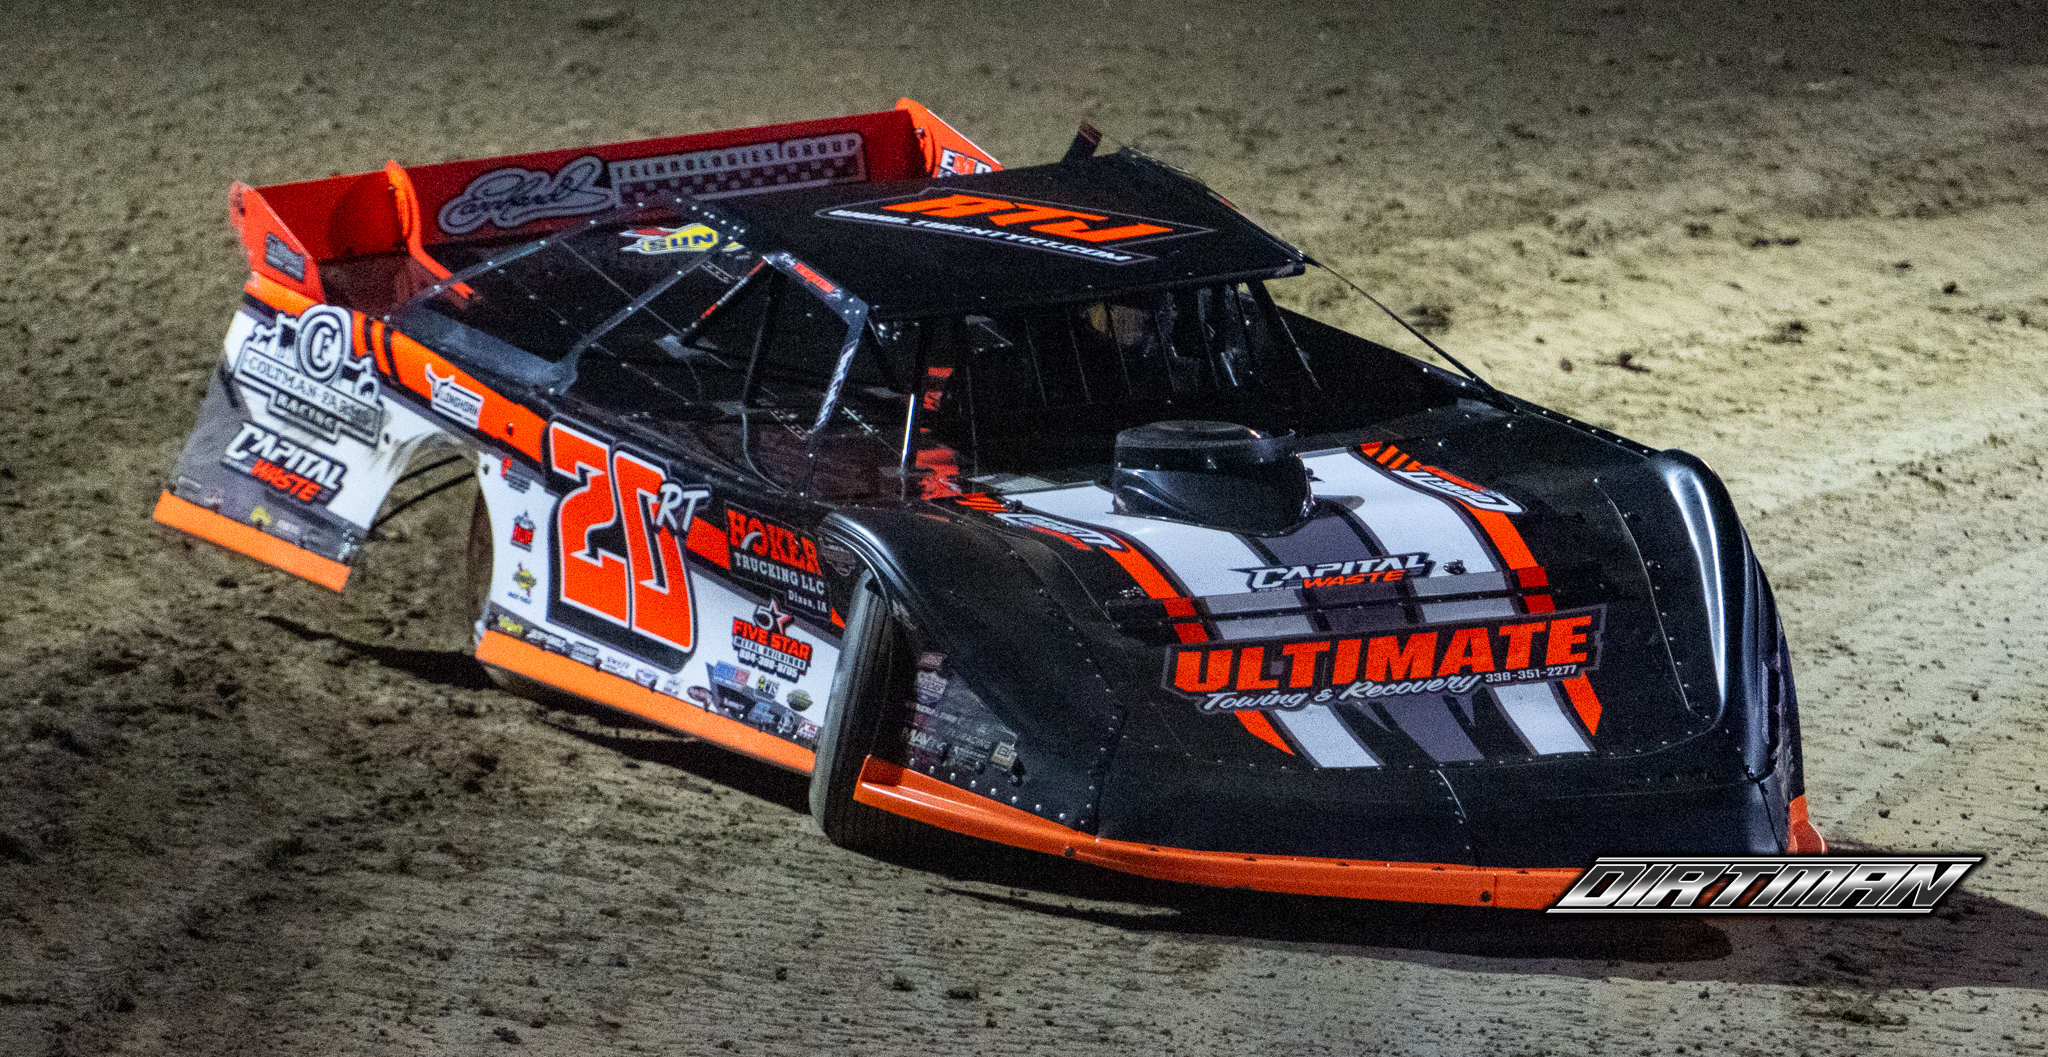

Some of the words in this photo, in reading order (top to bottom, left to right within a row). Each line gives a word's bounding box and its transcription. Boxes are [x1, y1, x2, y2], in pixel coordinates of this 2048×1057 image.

[616, 149, 773, 178] TECHNOLOGIES
[789, 137, 857, 159] GROUP
[278, 394, 336, 431] RACING
[226, 422, 347, 490] CAPITAL
[250, 459, 321, 501] WASTE
[655, 484, 710, 530] RT
[727, 508, 823, 576] HOKER
[734, 550, 799, 588] TRUCKING
[800, 570, 826, 596] LLC
[1252, 554, 1426, 588] CAPITAL
[1304, 569, 1405, 588] WASTE
[733, 618, 768, 645] FIVE
[770, 632, 811, 661] STAR
[1174, 615, 1592, 692] ULTIMATE
[1202, 688, 1309, 711] Towing
[1314, 686, 1332, 703] &
[1338, 673, 1482, 701] Recovery
